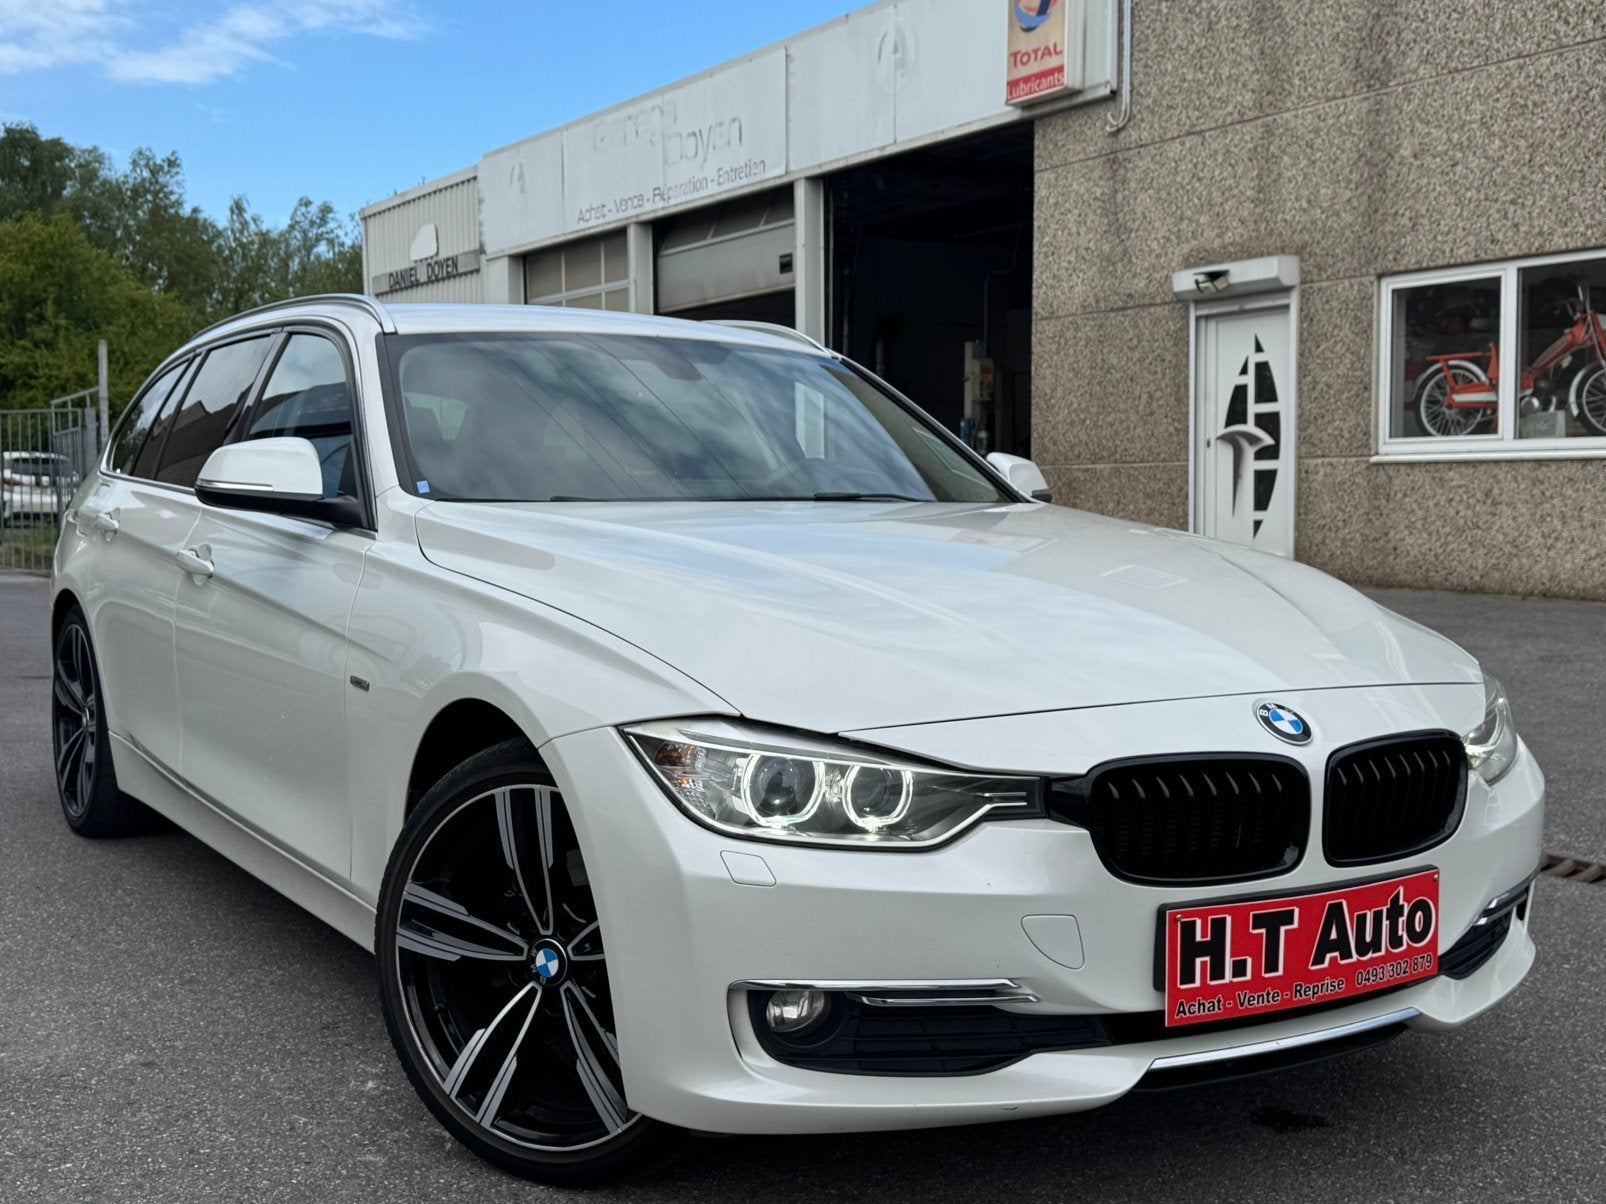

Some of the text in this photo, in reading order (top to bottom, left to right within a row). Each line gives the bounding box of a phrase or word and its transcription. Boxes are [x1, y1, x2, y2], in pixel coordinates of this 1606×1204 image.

[1010, 43, 1063, 68] TOTAL
[1007, 71, 1064, 99] Lubricants
[717, 158, 766, 186] Entretien
[388, 254, 459, 290] DANIEL DOYEN
[1177, 885, 1436, 989] H.T Auto
[1412, 952, 1433, 973] 879
[1175, 994, 1222, 1018] Achat
[1236, 988, 1280, 1009] Vente
[1293, 976, 1346, 1000] Reprise
